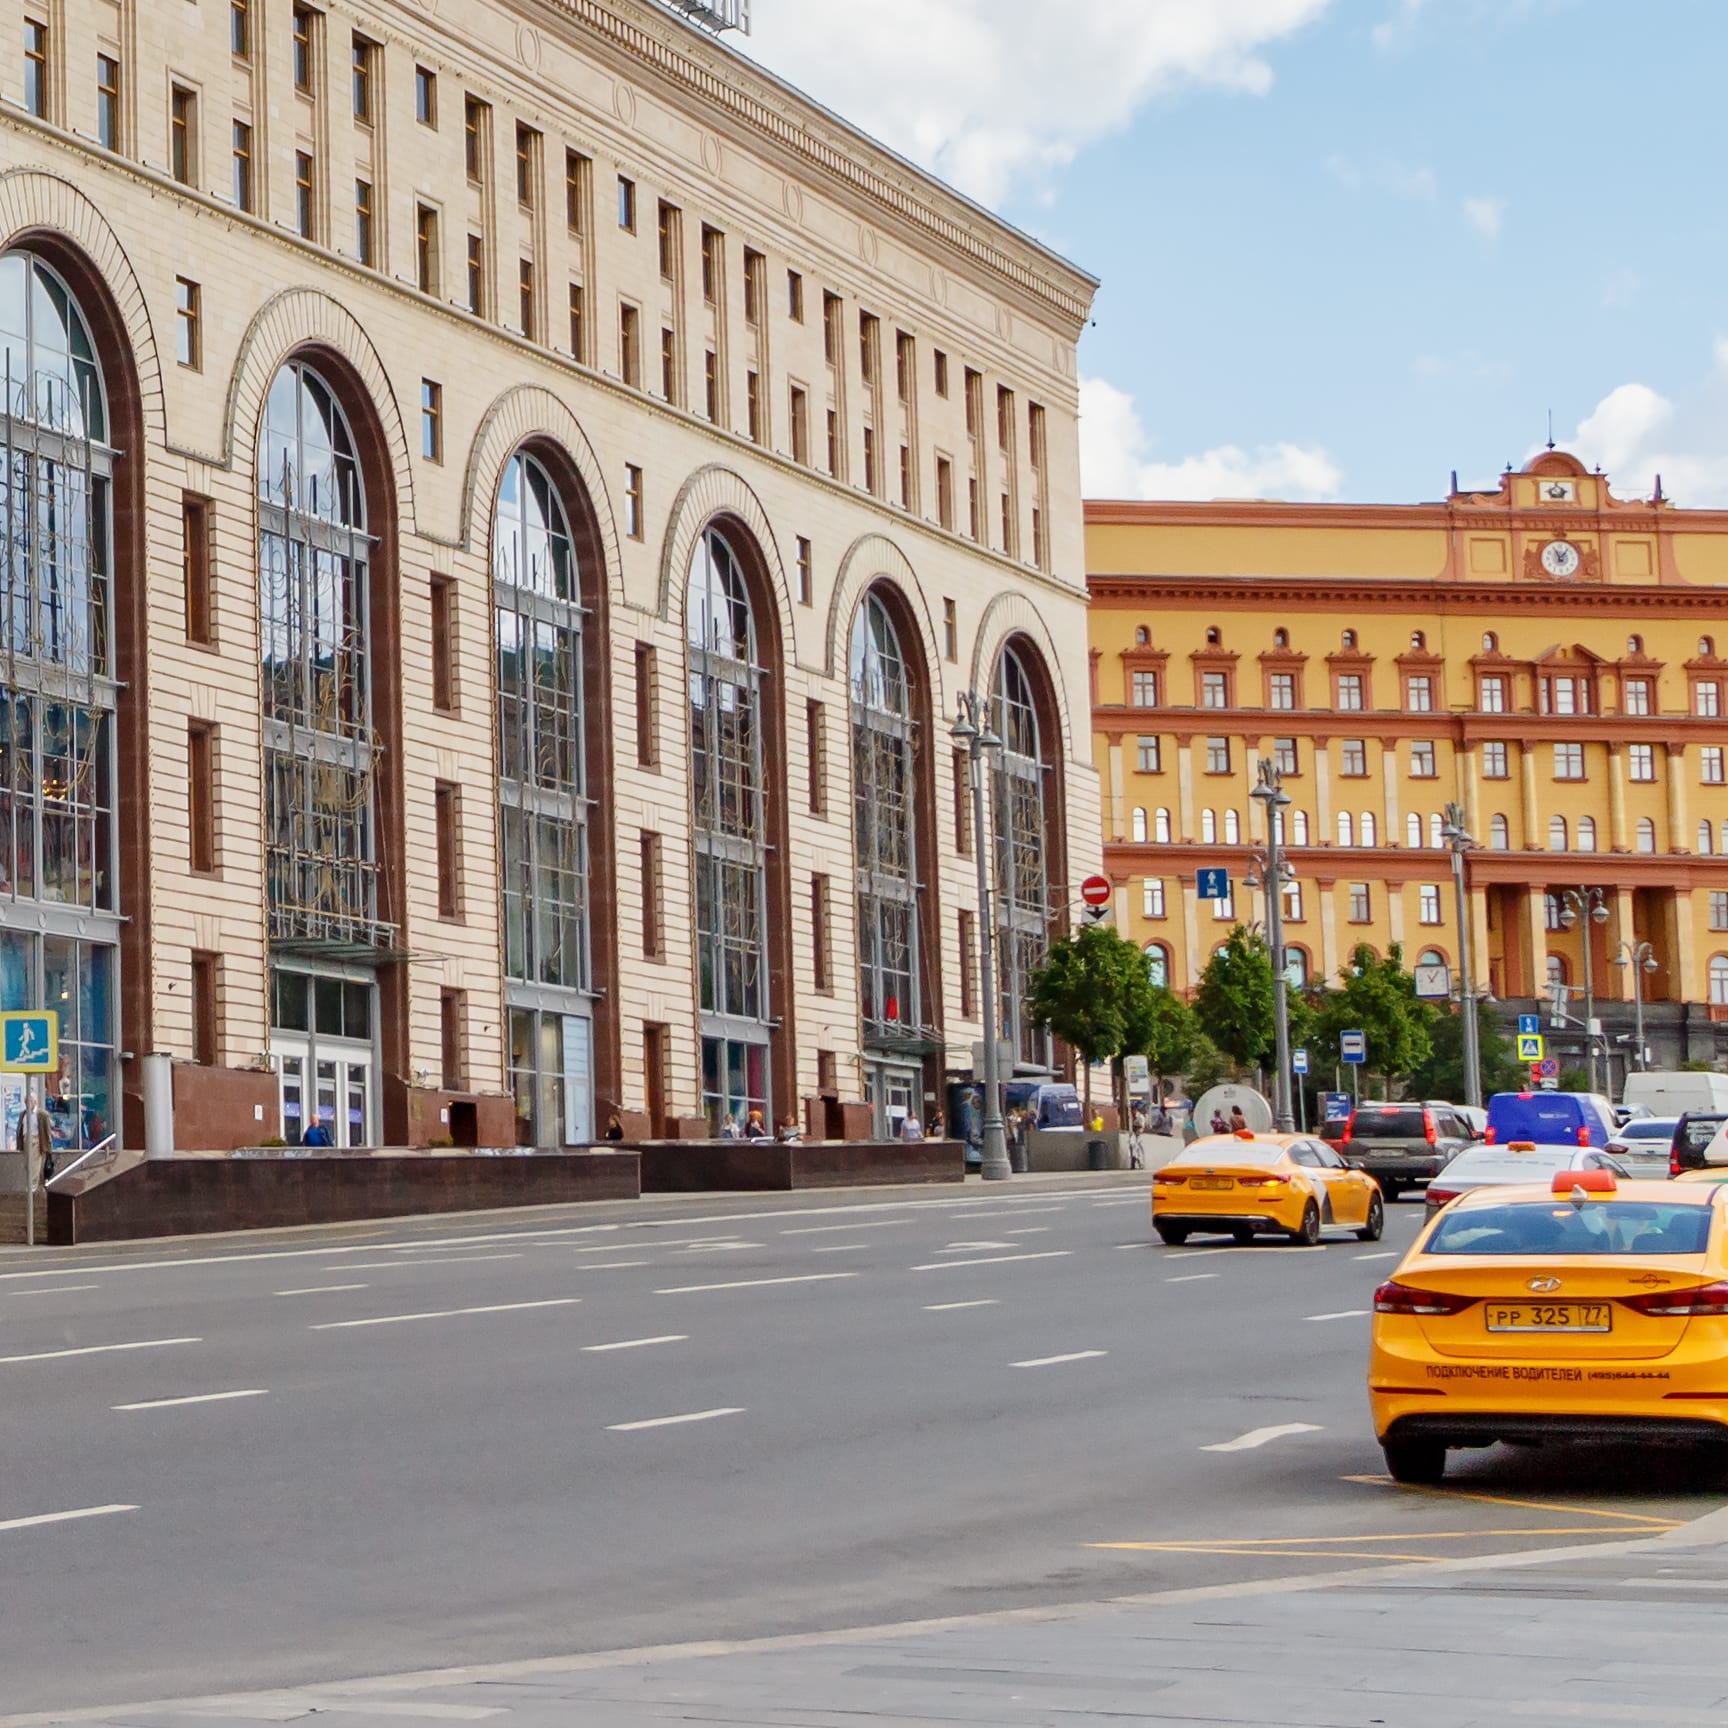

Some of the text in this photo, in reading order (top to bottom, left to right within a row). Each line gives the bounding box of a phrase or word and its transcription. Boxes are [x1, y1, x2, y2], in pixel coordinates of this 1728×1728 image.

[1531, 1307, 1570, 1325] 325
[1582, 1306, 1602, 1321] 77
[1426, 1365, 1510, 1379] ПОДКЛЮЧЕНИЕ
[1512, 1366, 1583, 1381] ВОДИТЕЛЕЙ
